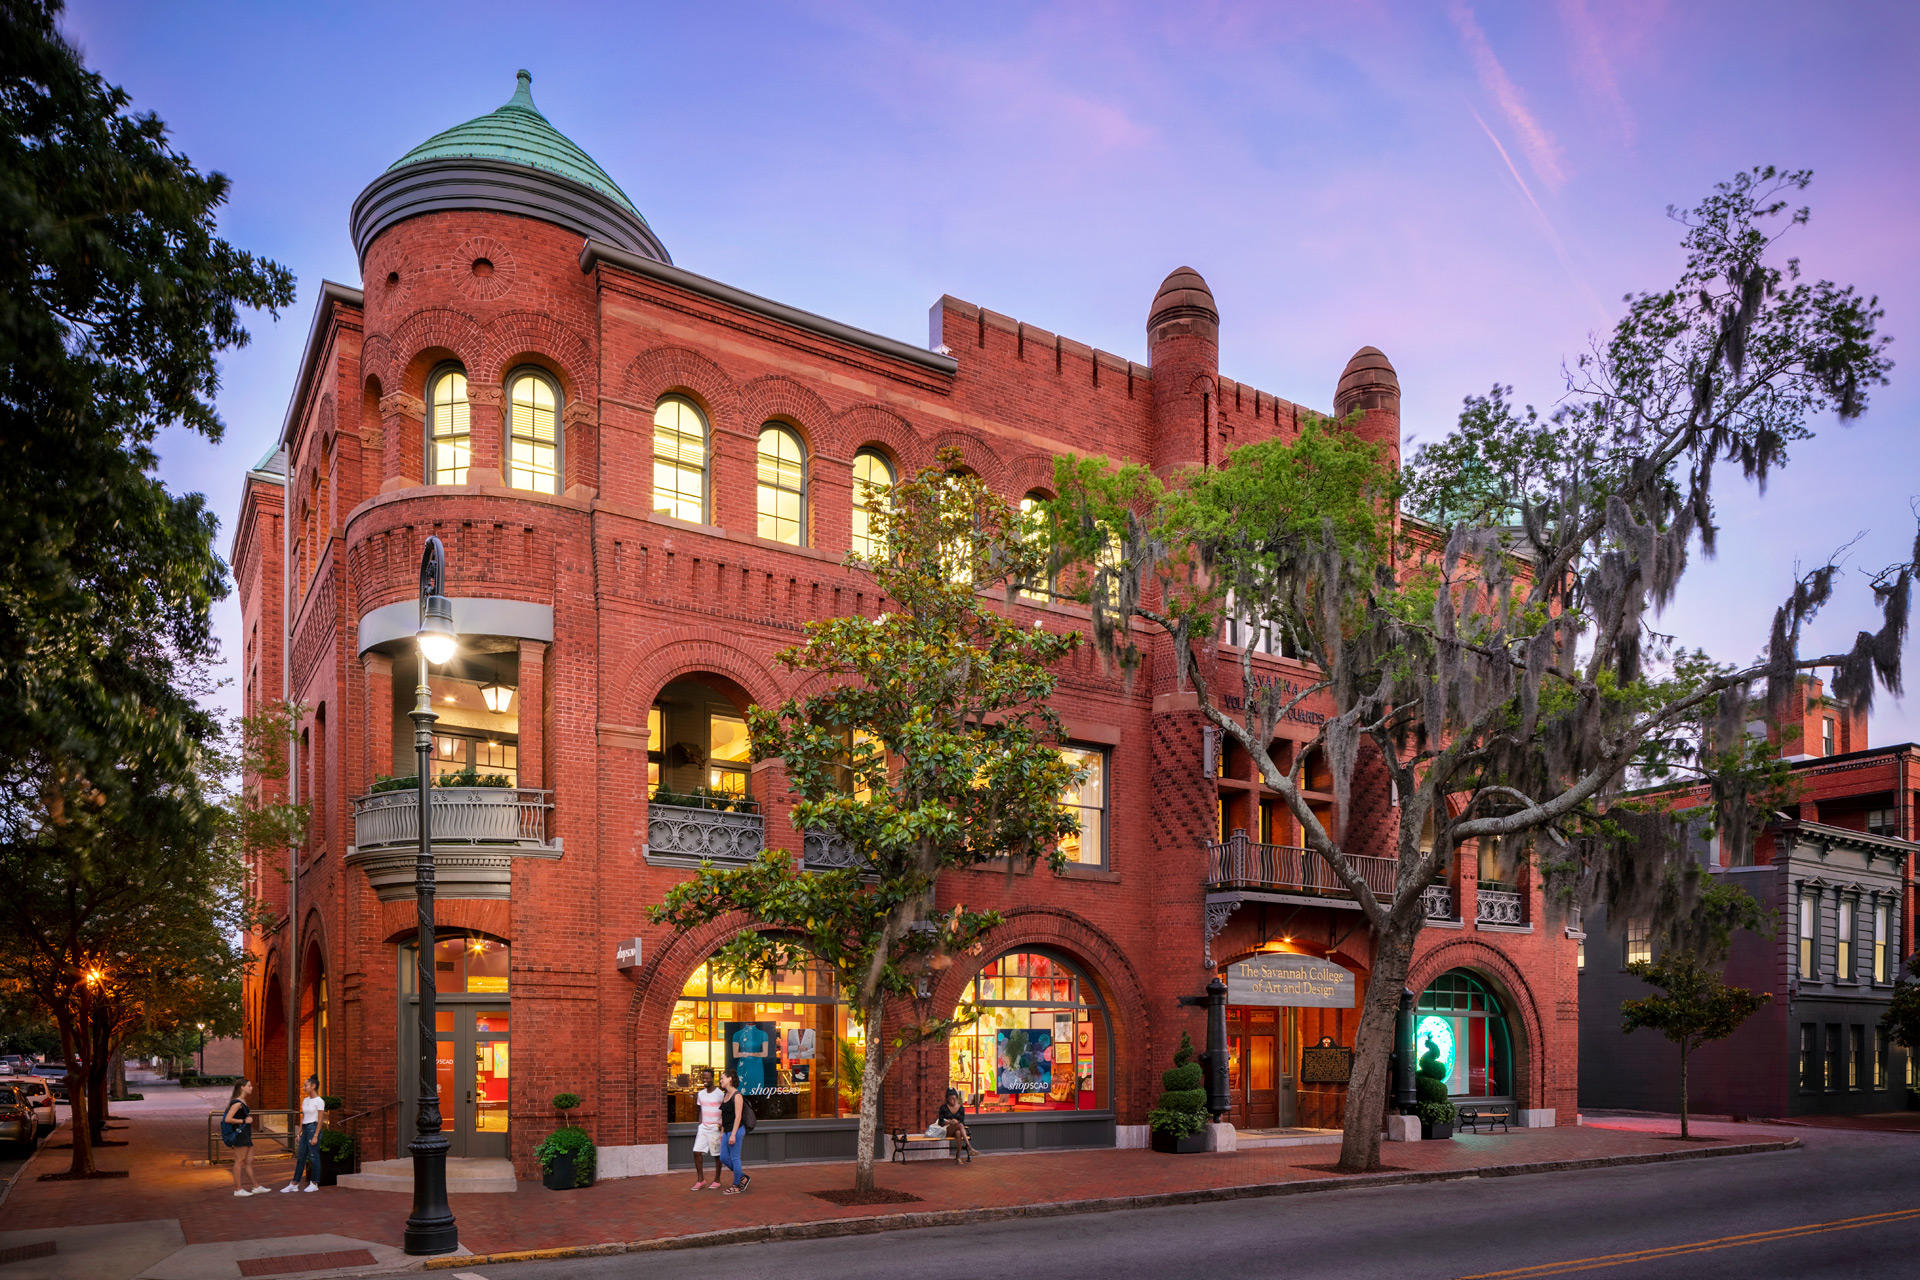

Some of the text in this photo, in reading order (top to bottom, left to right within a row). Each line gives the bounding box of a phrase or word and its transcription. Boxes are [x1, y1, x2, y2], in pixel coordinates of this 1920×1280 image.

[1242, 674, 1308, 699] SAVANNA
[1287, 708, 1325, 725] GUARDS
[1239, 963, 1344, 984] The Savannah College
[1252, 979, 1335, 998] of Art and Design
